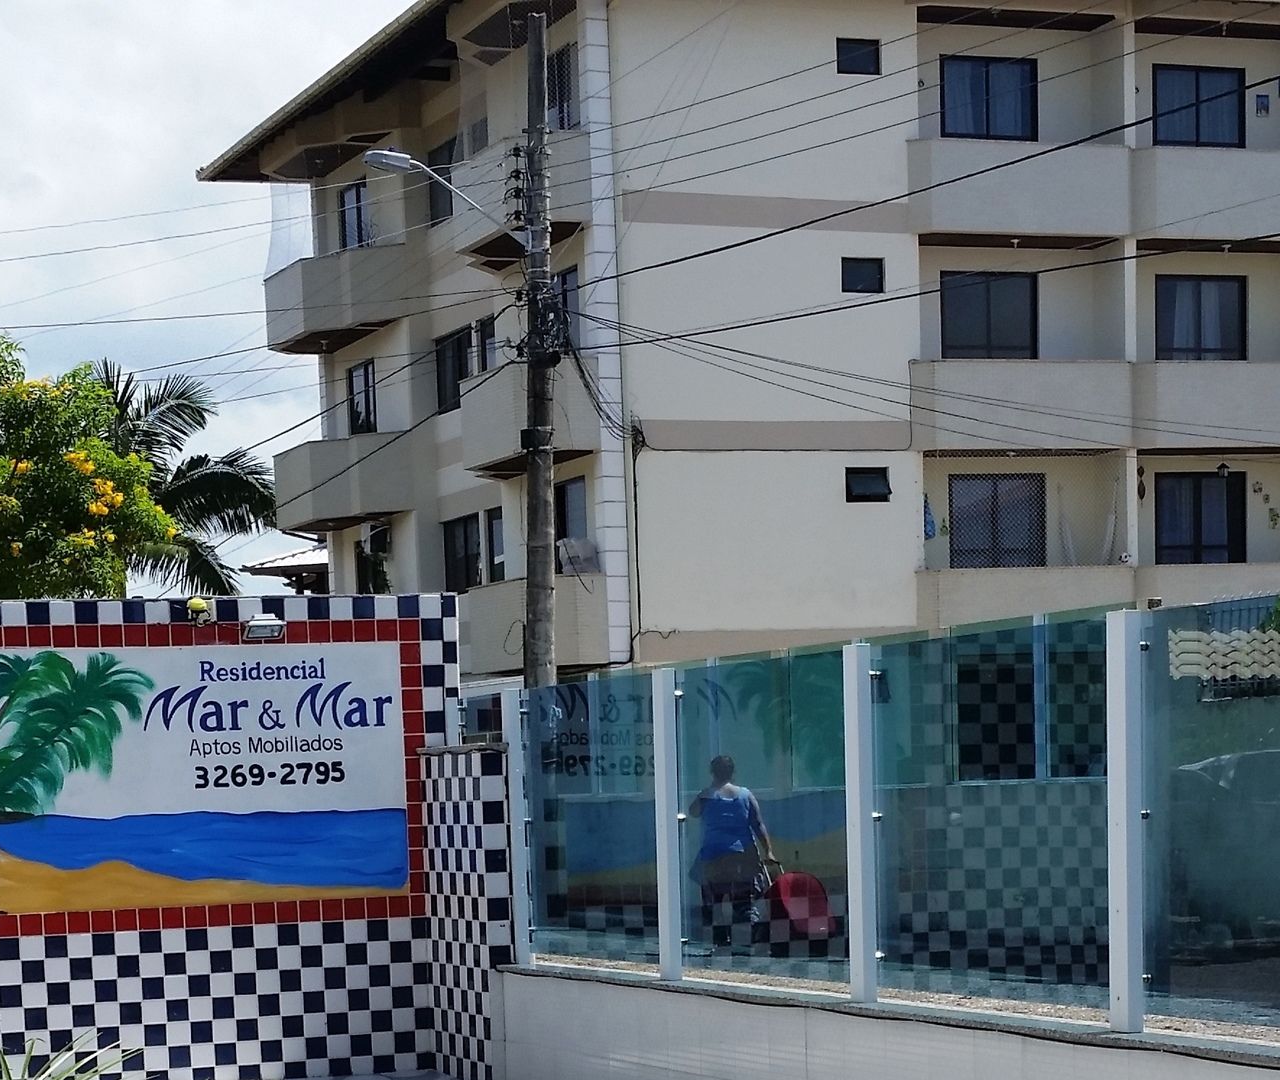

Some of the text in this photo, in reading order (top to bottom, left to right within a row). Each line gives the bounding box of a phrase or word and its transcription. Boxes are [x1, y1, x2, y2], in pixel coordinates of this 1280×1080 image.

[199, 658, 326, 682] Residencial
[143, 682, 393, 732] Mar & Mar
[190, 734, 343, 758] Aptos Mobiliados
[194, 761, 346, 789] 3269-2795
